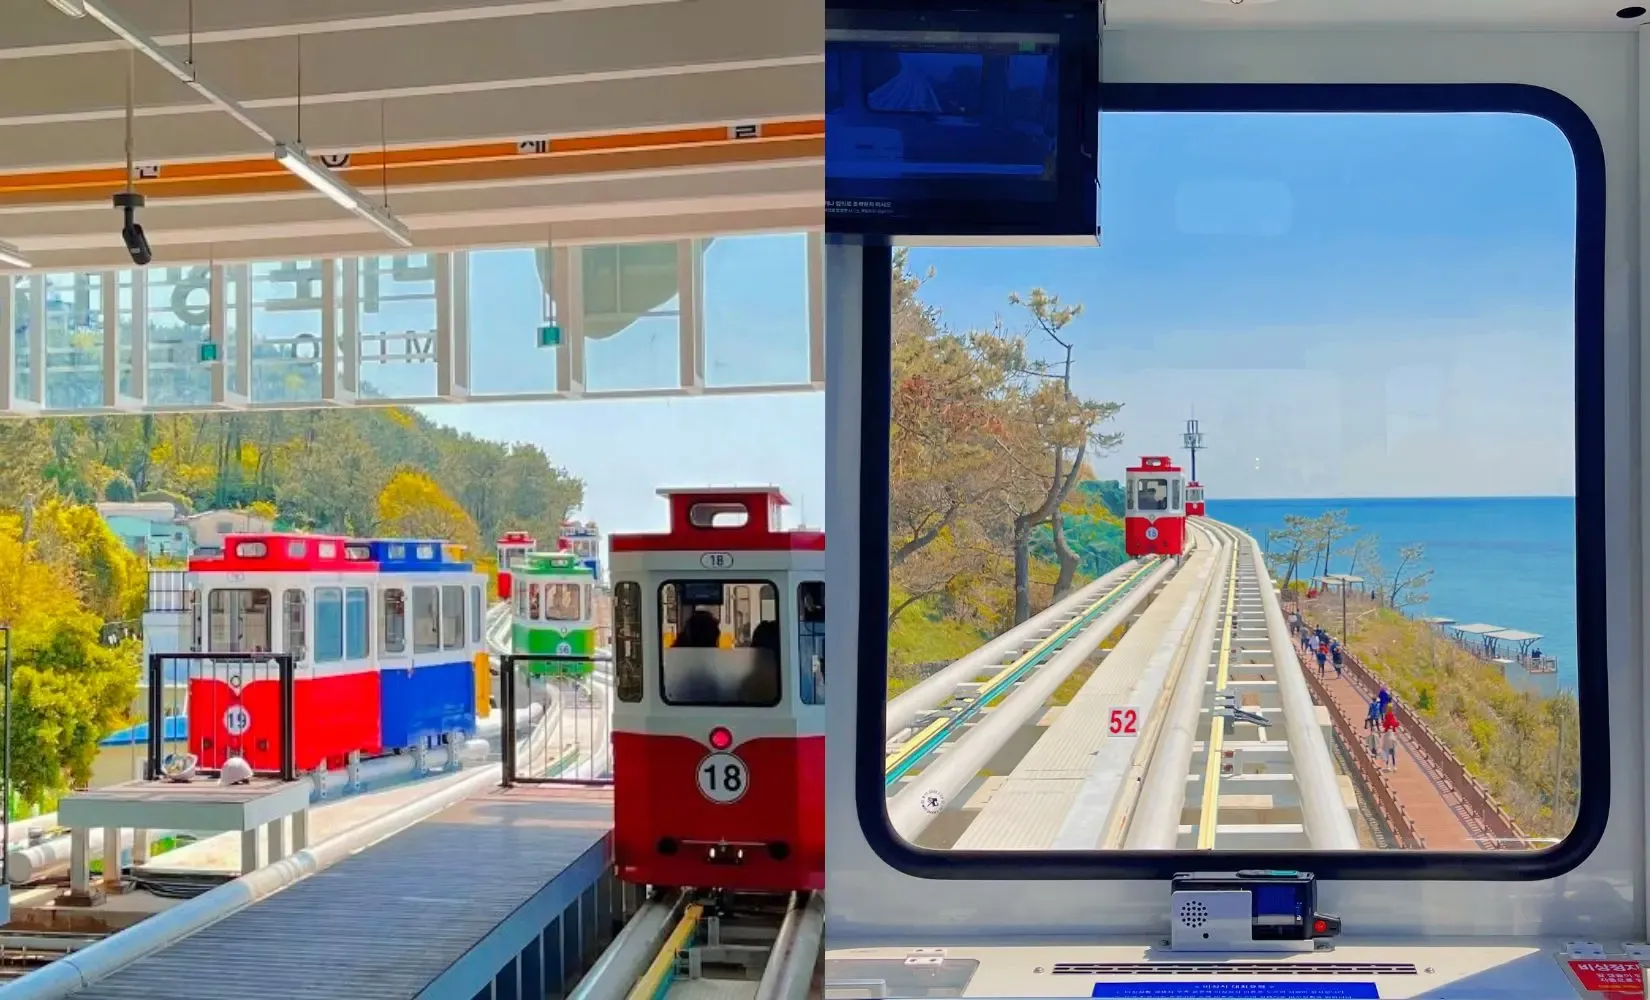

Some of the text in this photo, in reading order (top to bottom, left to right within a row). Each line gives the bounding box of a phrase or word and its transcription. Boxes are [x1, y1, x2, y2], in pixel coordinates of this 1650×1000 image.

[710, 554, 724, 566] 18
[229, 712, 247, 729] 19
[1109, 709, 1137, 734] 52
[703, 763, 742, 792] 18
[1577, 963, 1640, 972] 비상정지
